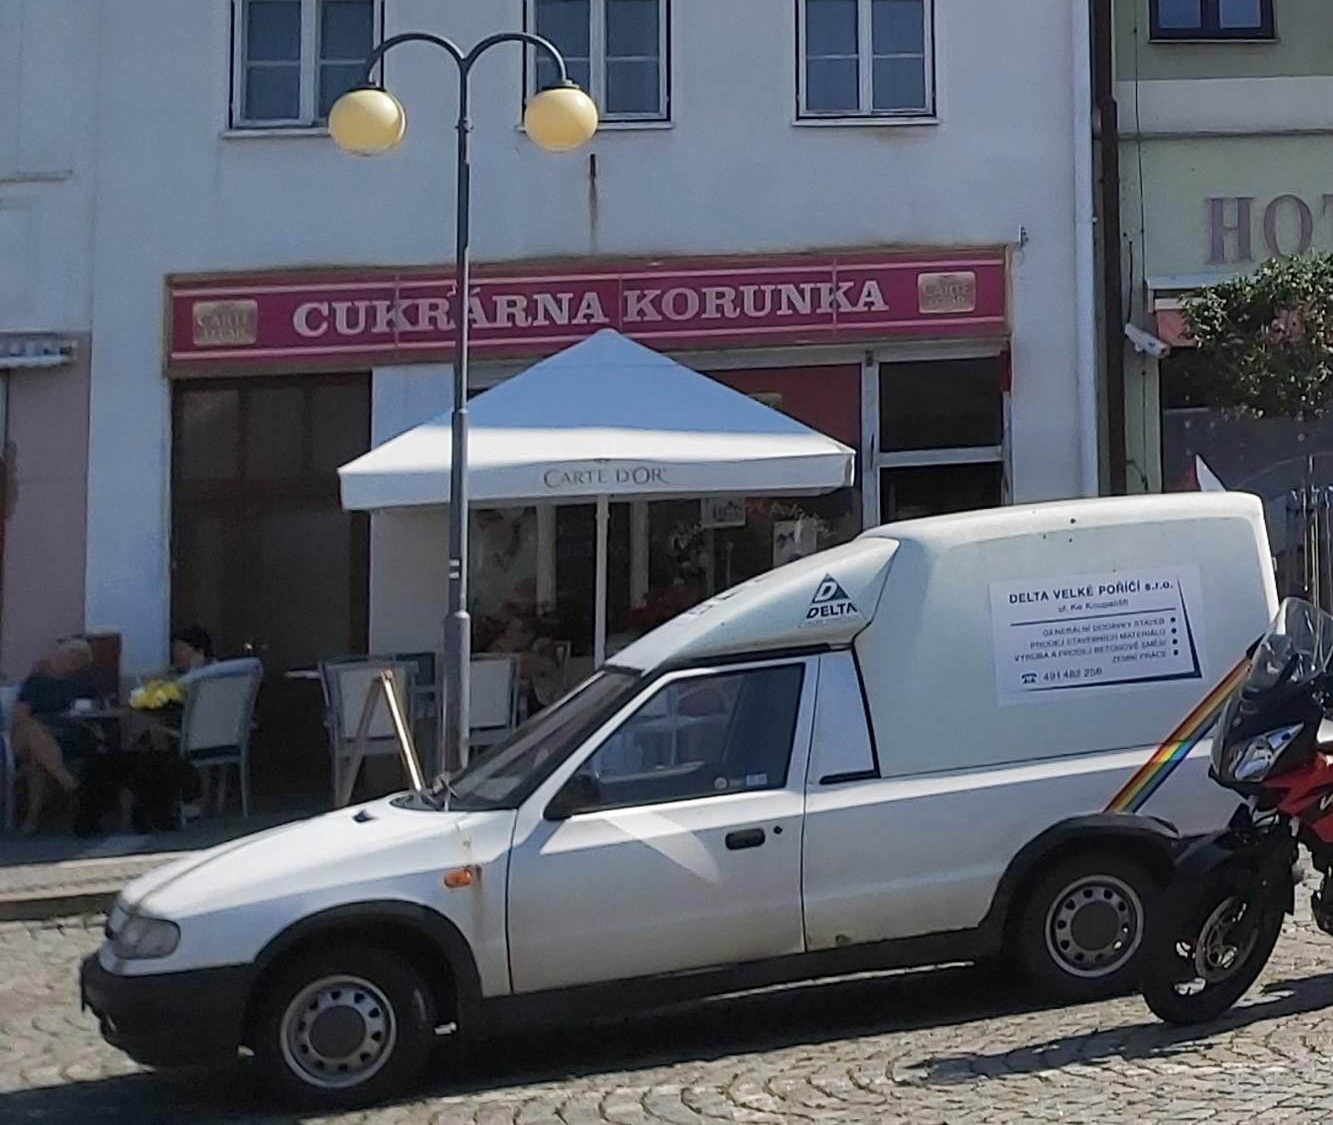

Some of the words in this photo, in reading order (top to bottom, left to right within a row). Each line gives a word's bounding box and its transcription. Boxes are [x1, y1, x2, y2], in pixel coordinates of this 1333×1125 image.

[292, 286, 610, 338] CUKRÁRNA
[622, 279, 890, 323] KORUNKA
[543, 468, 608, 489] CARTE
[1009, 591, 1049, 604] DELTA
[1053, 584, 1094, 599] VELKÉ
[1099, 579, 1140, 596] POŘÍČÍ
[1144, 580, 1174, 591] s.r.o.
[805, 602, 858, 619] DELTA
